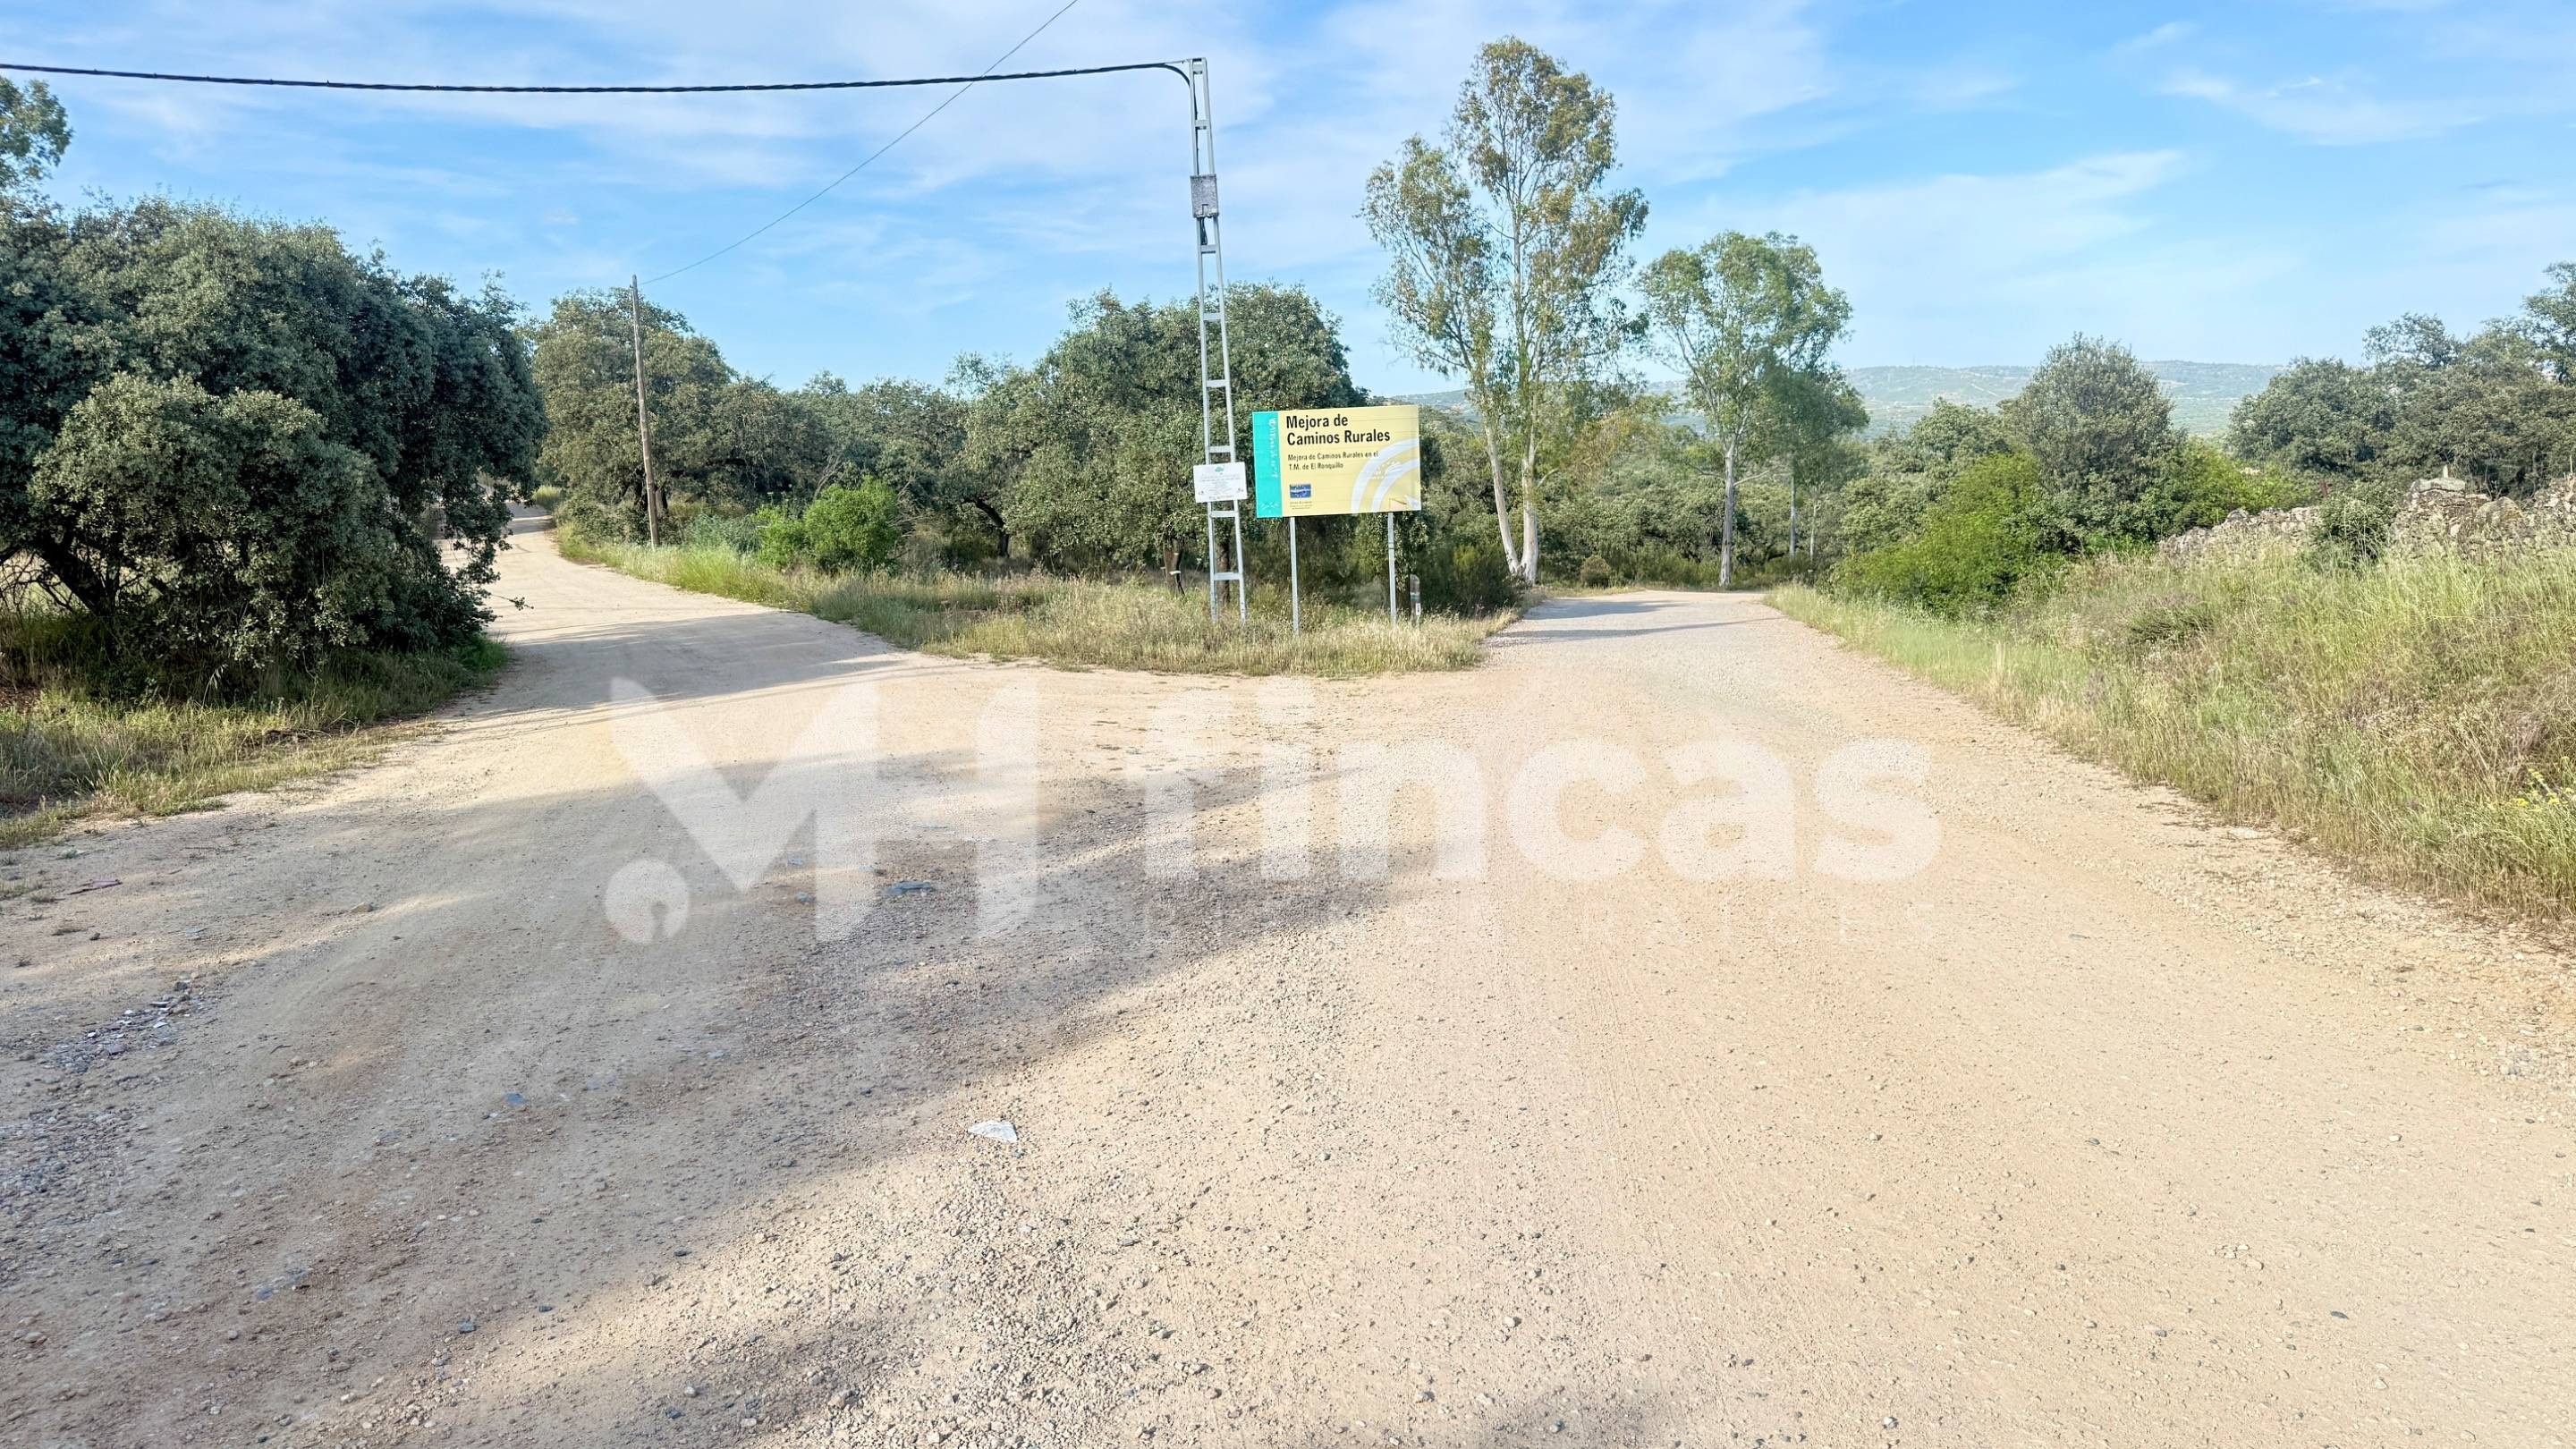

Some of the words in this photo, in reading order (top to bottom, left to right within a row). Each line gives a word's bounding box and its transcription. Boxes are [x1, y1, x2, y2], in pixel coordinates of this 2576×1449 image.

[1286, 415, 1329, 431] Mejora
[1334, 413, 1349, 427] de
[1287, 432, 1340, 445] Caminos
[1344, 428, 1391, 443] Rurales
[1287, 453, 1308, 462] Mejora
[1318, 462, 1343, 470] Ronquillo
